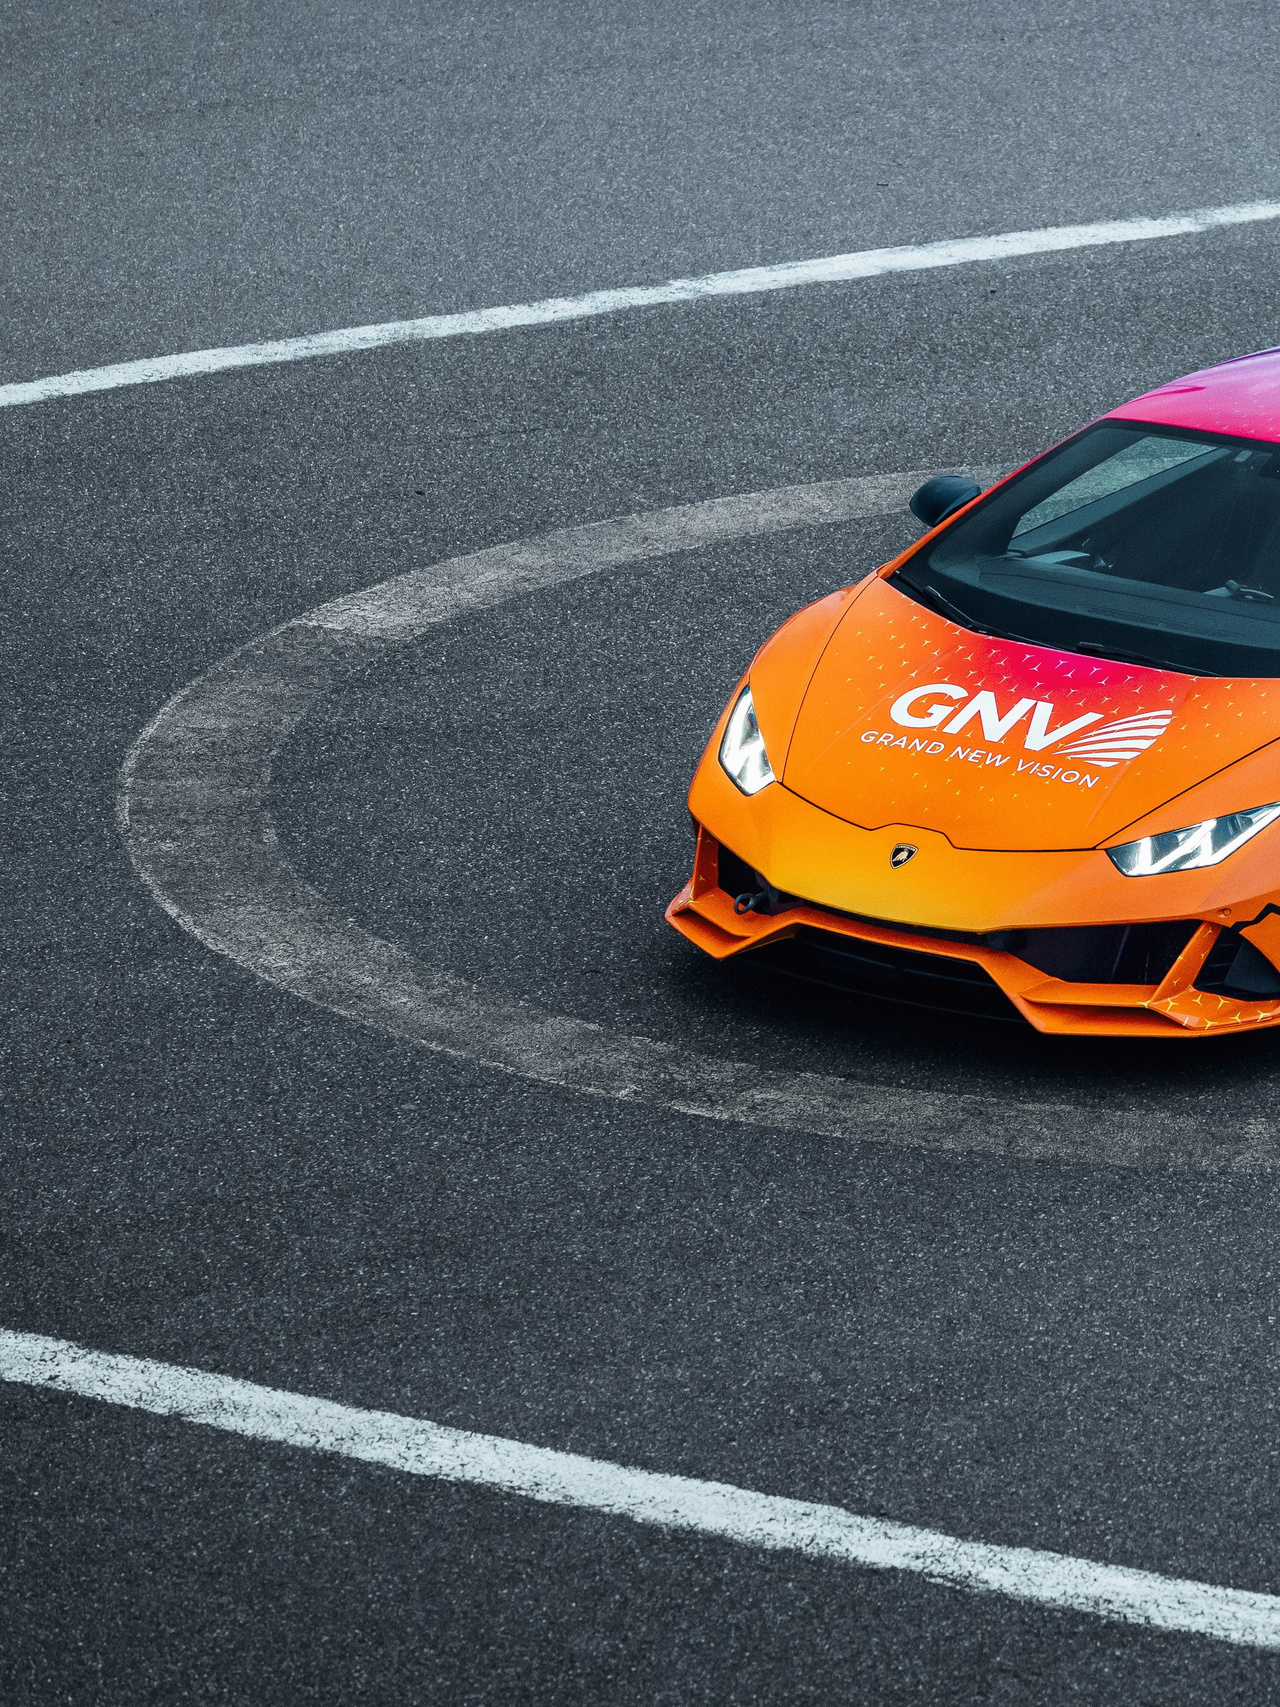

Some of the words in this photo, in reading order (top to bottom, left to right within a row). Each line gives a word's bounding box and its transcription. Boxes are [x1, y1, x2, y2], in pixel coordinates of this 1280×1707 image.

[889, 683, 1105, 751] GNV
[860, 730, 945, 755] GRAND
[950, 746, 1010, 769] NEW
[1016, 758, 1100, 788] VISION
